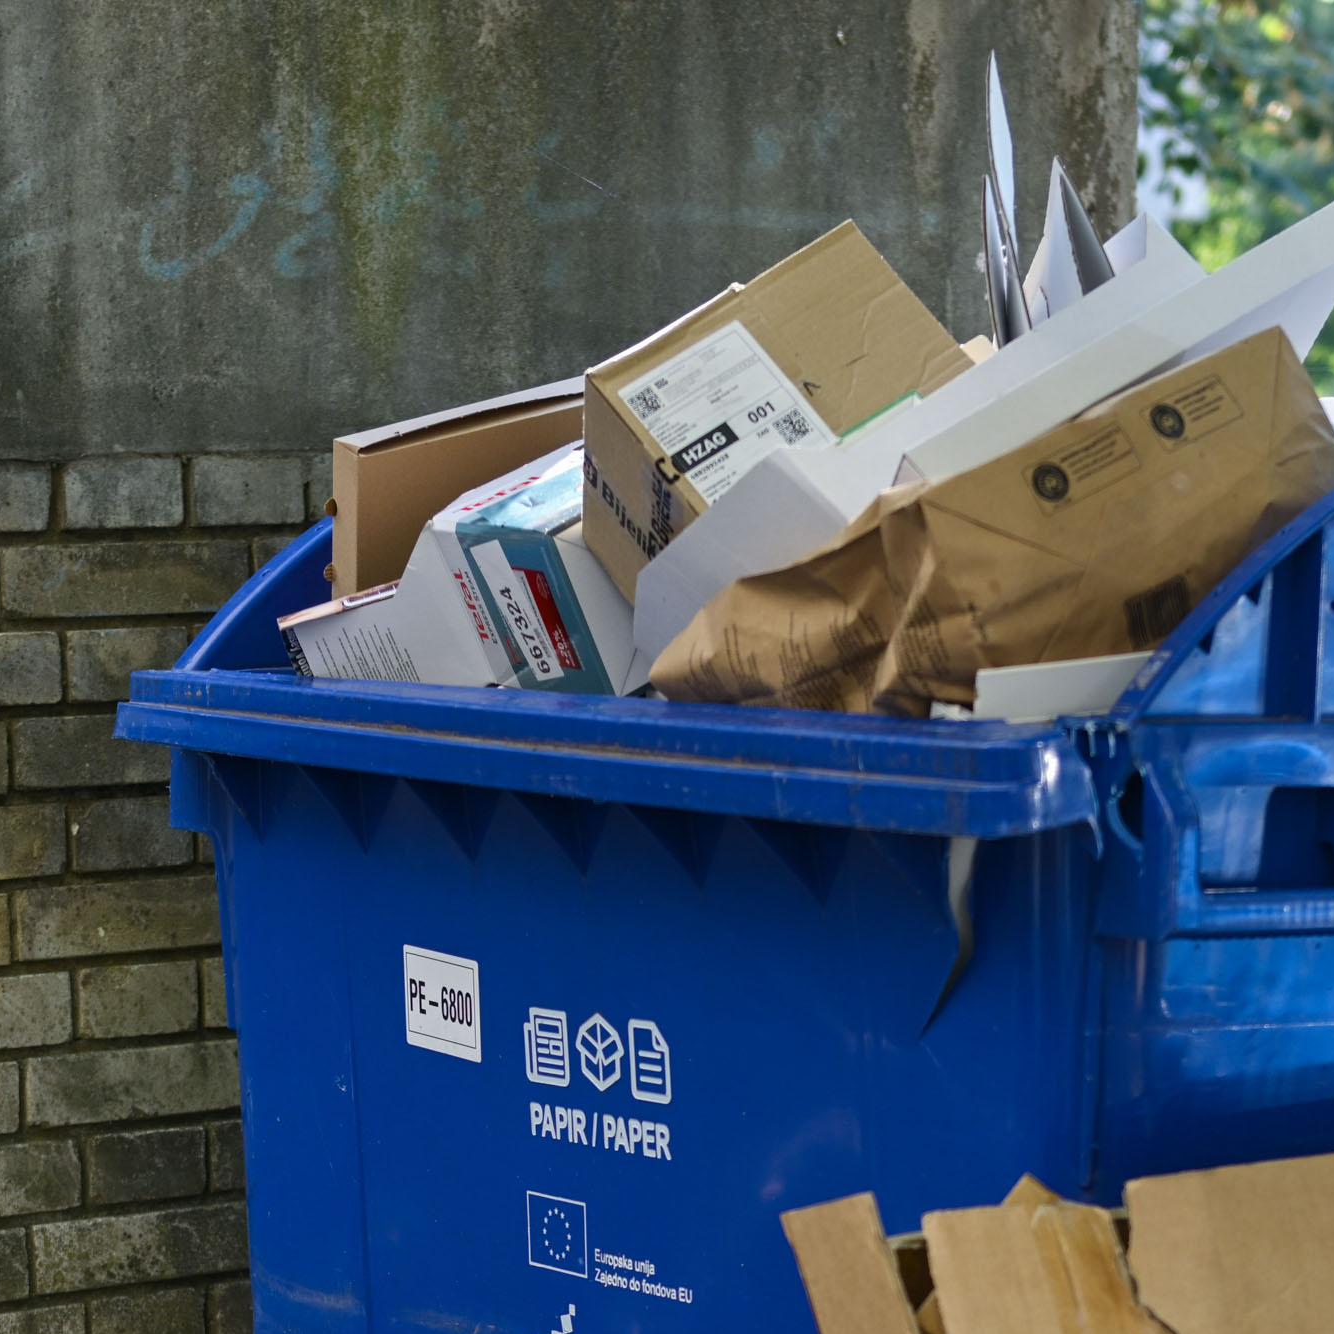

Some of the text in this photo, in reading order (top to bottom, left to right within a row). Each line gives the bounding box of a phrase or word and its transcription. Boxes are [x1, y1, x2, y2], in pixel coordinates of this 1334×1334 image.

[747, 401, 776, 425] 001
[680, 430, 728, 467] HZAG
[499, 586, 551, 674] 667324
[529, 1101, 672, 1161] PAPIR / PAPER
[594, 1248, 655, 1276] Europska unija
[594, 1268, 693, 1304] Zajedno do fondova EU
